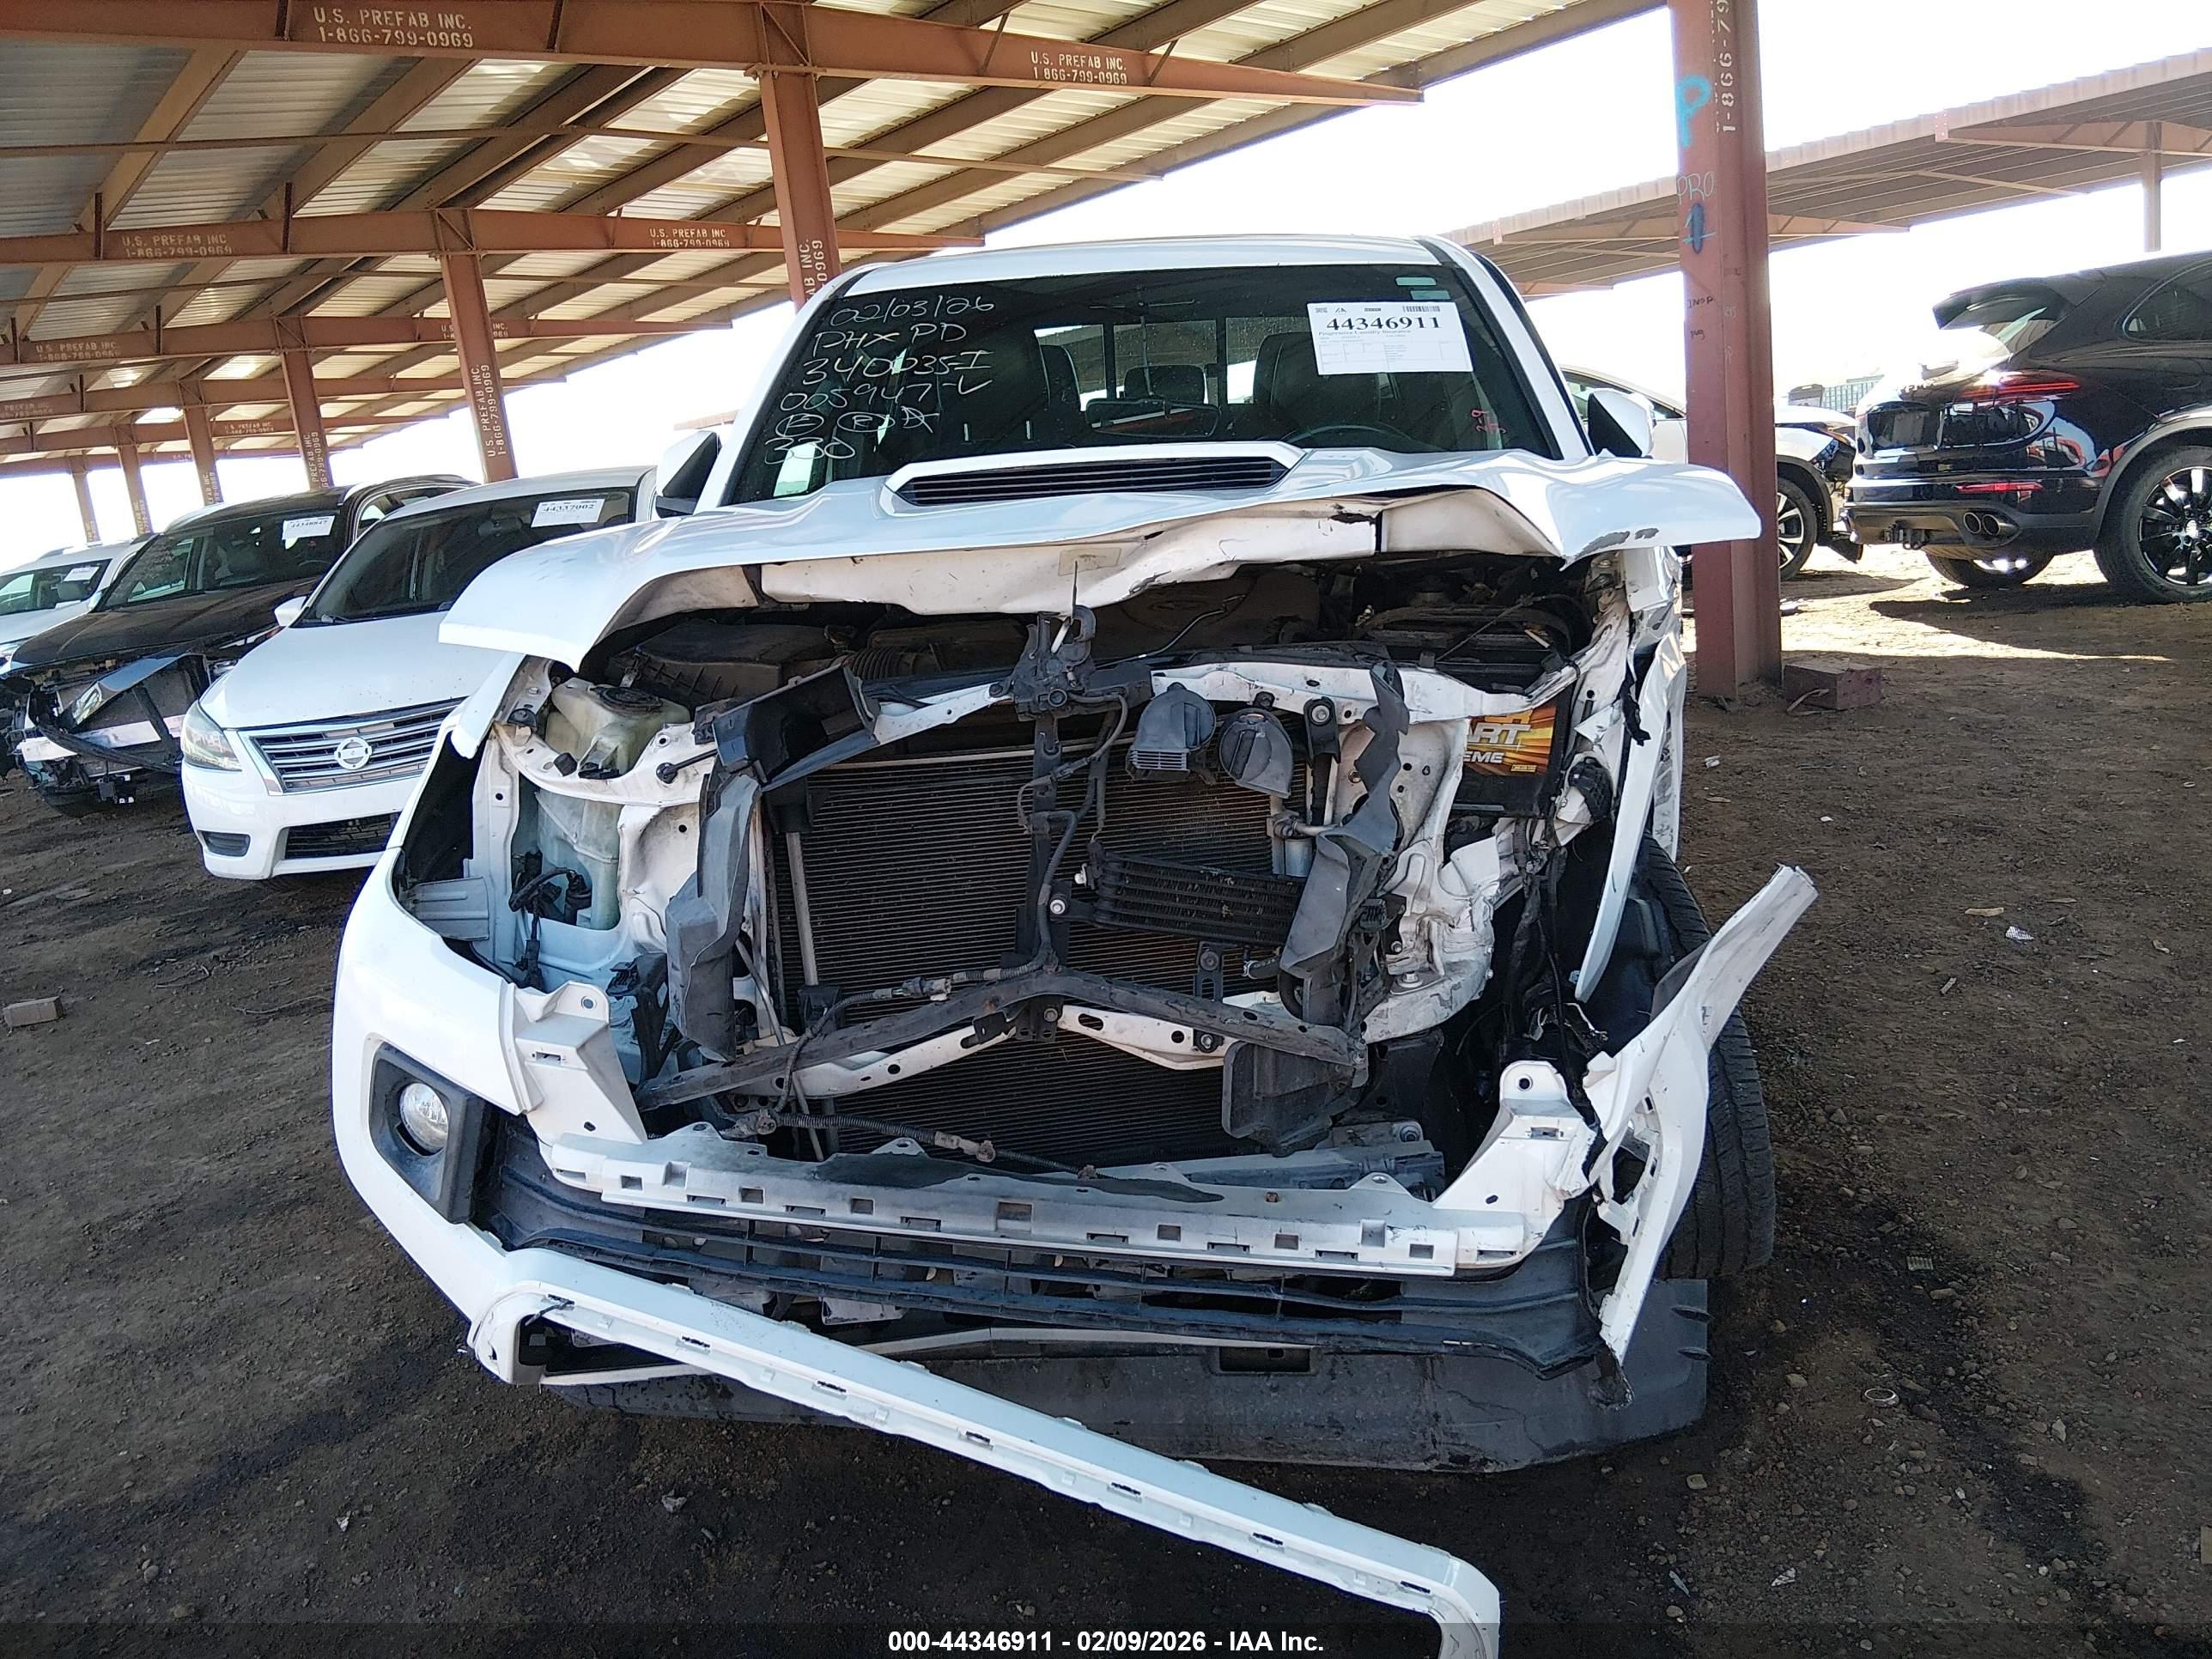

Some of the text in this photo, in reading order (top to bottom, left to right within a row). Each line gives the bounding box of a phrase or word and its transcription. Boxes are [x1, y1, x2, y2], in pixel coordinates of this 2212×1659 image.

[313, 7, 472, 30] U.S. PREFAB INC.
[319, 26, 473, 48] 1-866-799-0969
[1030, 51, 1127, 70] U.S. PREFAB INC.
[1677, 171, 1714, 205] PRO
[122, 235, 147, 247] U.S.
[152, 234, 202, 246] PREFAB
[649, 228, 668, 238] U.S.
[672, 228, 708, 238] PREFAB
[799, 239, 812, 269] INC.
[830, 295, 995, 326] 02/03/26
[1327, 316, 1442, 331] 44346911
[813, 322, 967, 357] PHX PD
[471, 364, 496, 457] U.S. PREFAB INC.
[481, 364, 507, 456] 1-866-799-0969
